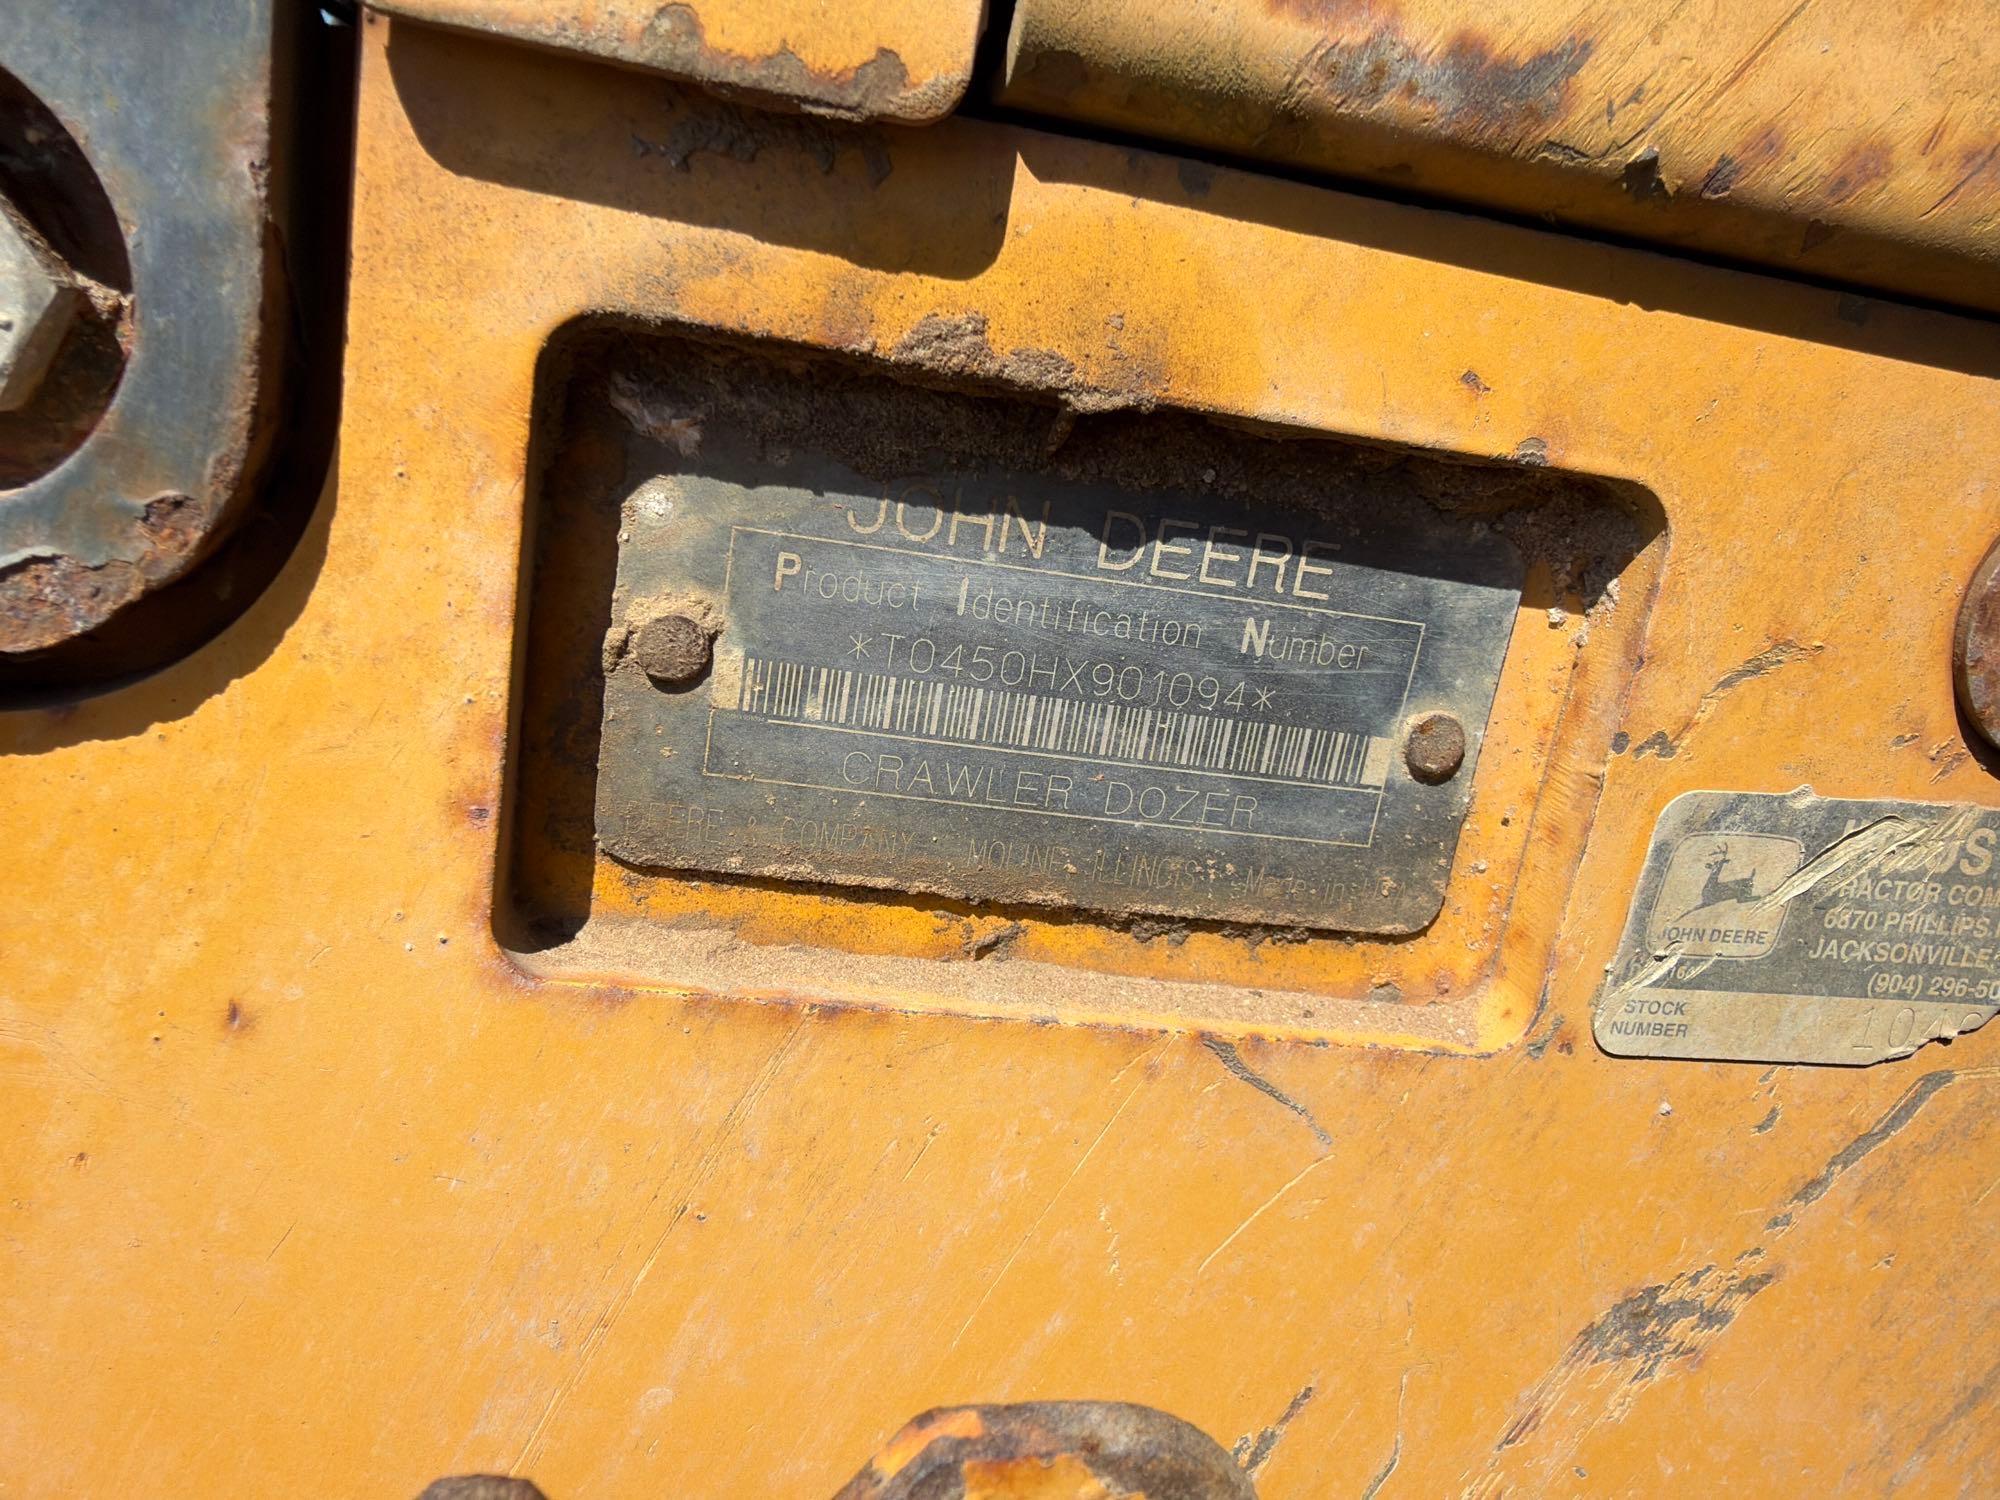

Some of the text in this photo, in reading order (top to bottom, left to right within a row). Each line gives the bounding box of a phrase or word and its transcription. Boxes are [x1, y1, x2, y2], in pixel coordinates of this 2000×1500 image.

[846, 477, 1342, 600] JOHN DEERE
[774, 551, 1370, 670] Product Identification Number
[842, 750, 1259, 829] CRAWLER DOZER
[1823, 908, 1878, 931] 6870
[1657, 926, 1768, 945] JOHN DEERE
[1867, 971, 1923, 999] (904)
[1624, 999, 1687, 1016] STOCK
[1610, 1021, 1689, 1038] NUMBER
